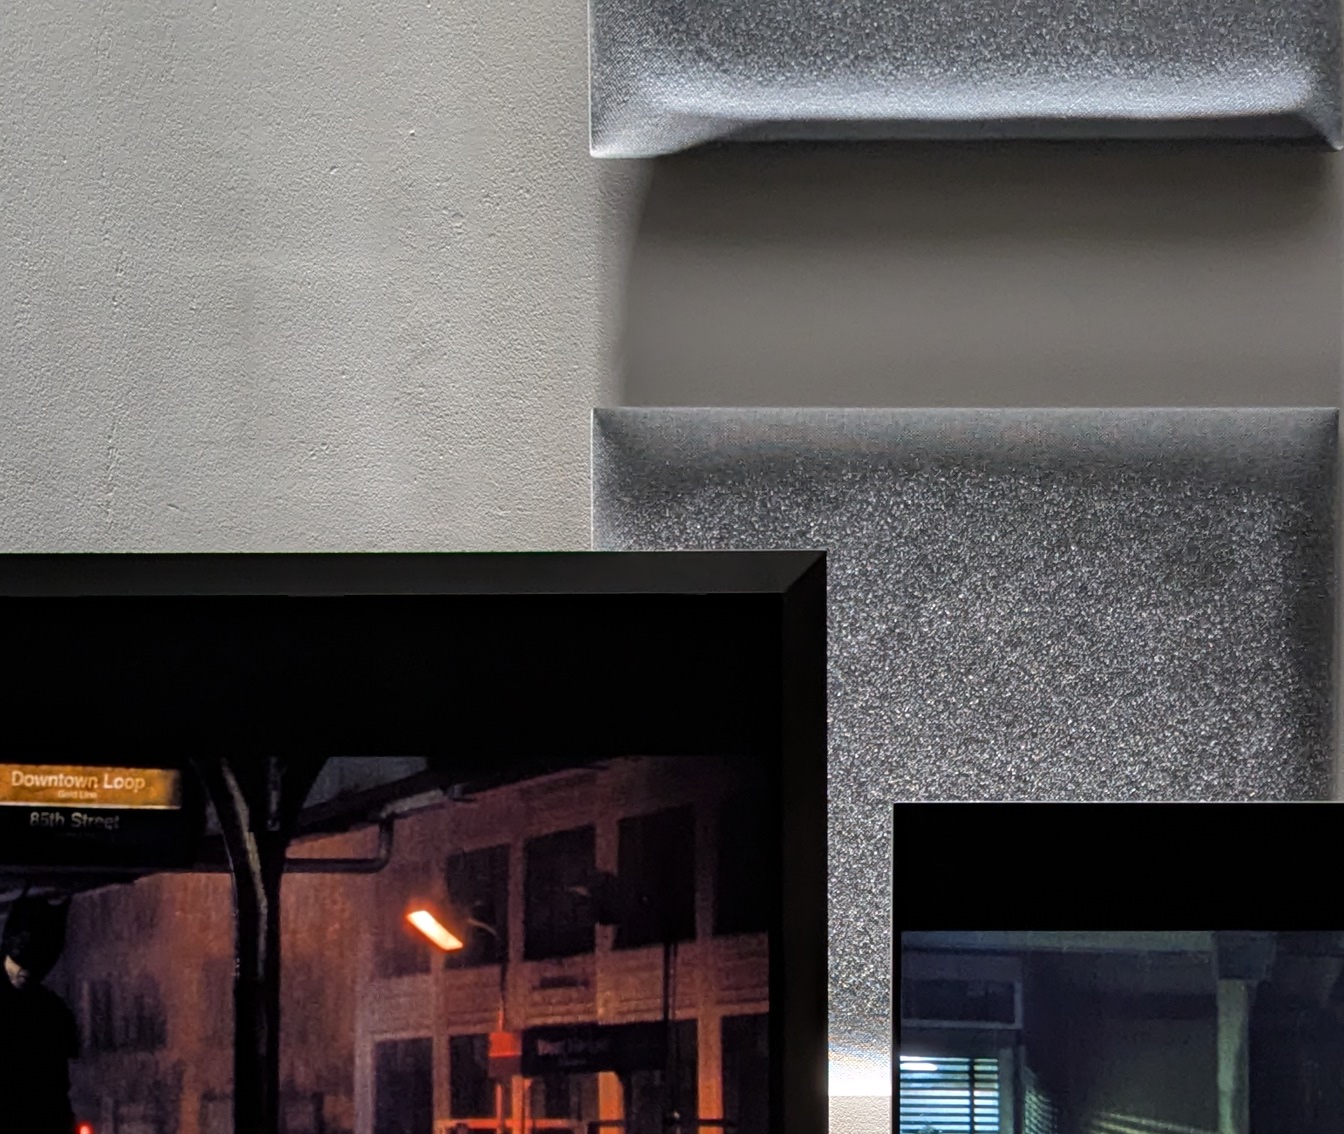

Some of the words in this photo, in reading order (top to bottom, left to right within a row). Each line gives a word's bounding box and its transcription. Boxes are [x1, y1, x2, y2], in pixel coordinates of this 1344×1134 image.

[11, 770, 98, 789] Downtown
[103, 773, 146, 793] Loop
[30, 811, 65, 827] 85th
[71, 812, 120, 830] Street
